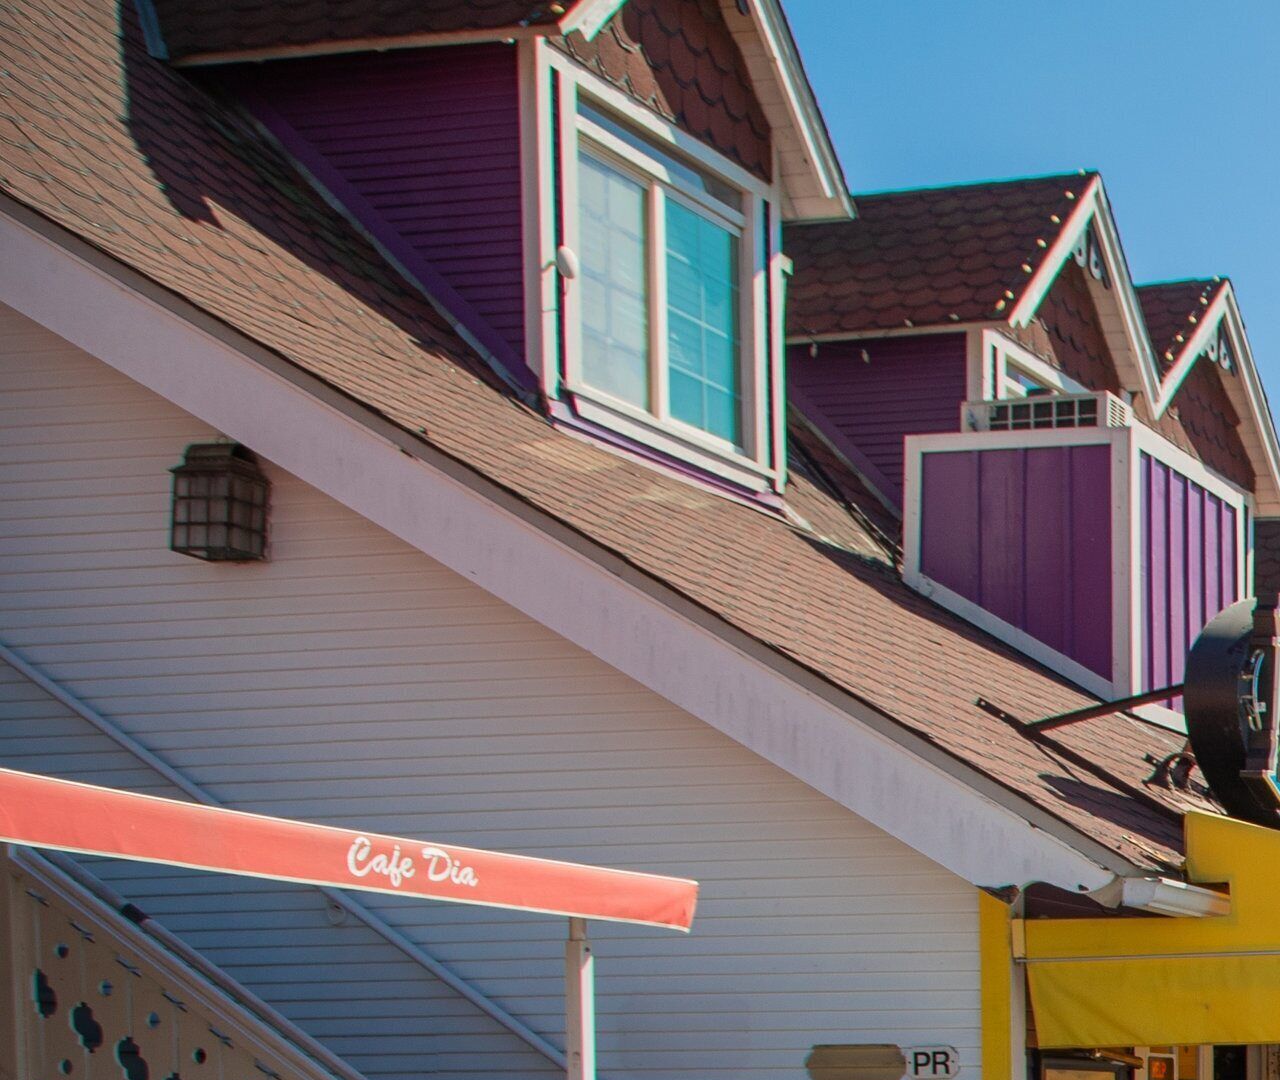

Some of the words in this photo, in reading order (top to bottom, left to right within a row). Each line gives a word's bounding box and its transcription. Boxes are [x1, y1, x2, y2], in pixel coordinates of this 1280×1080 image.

[347, 836, 415, 887] Cafe
[421, 847, 479, 887] Dia
[913, 1051, 950, 1076] PR
